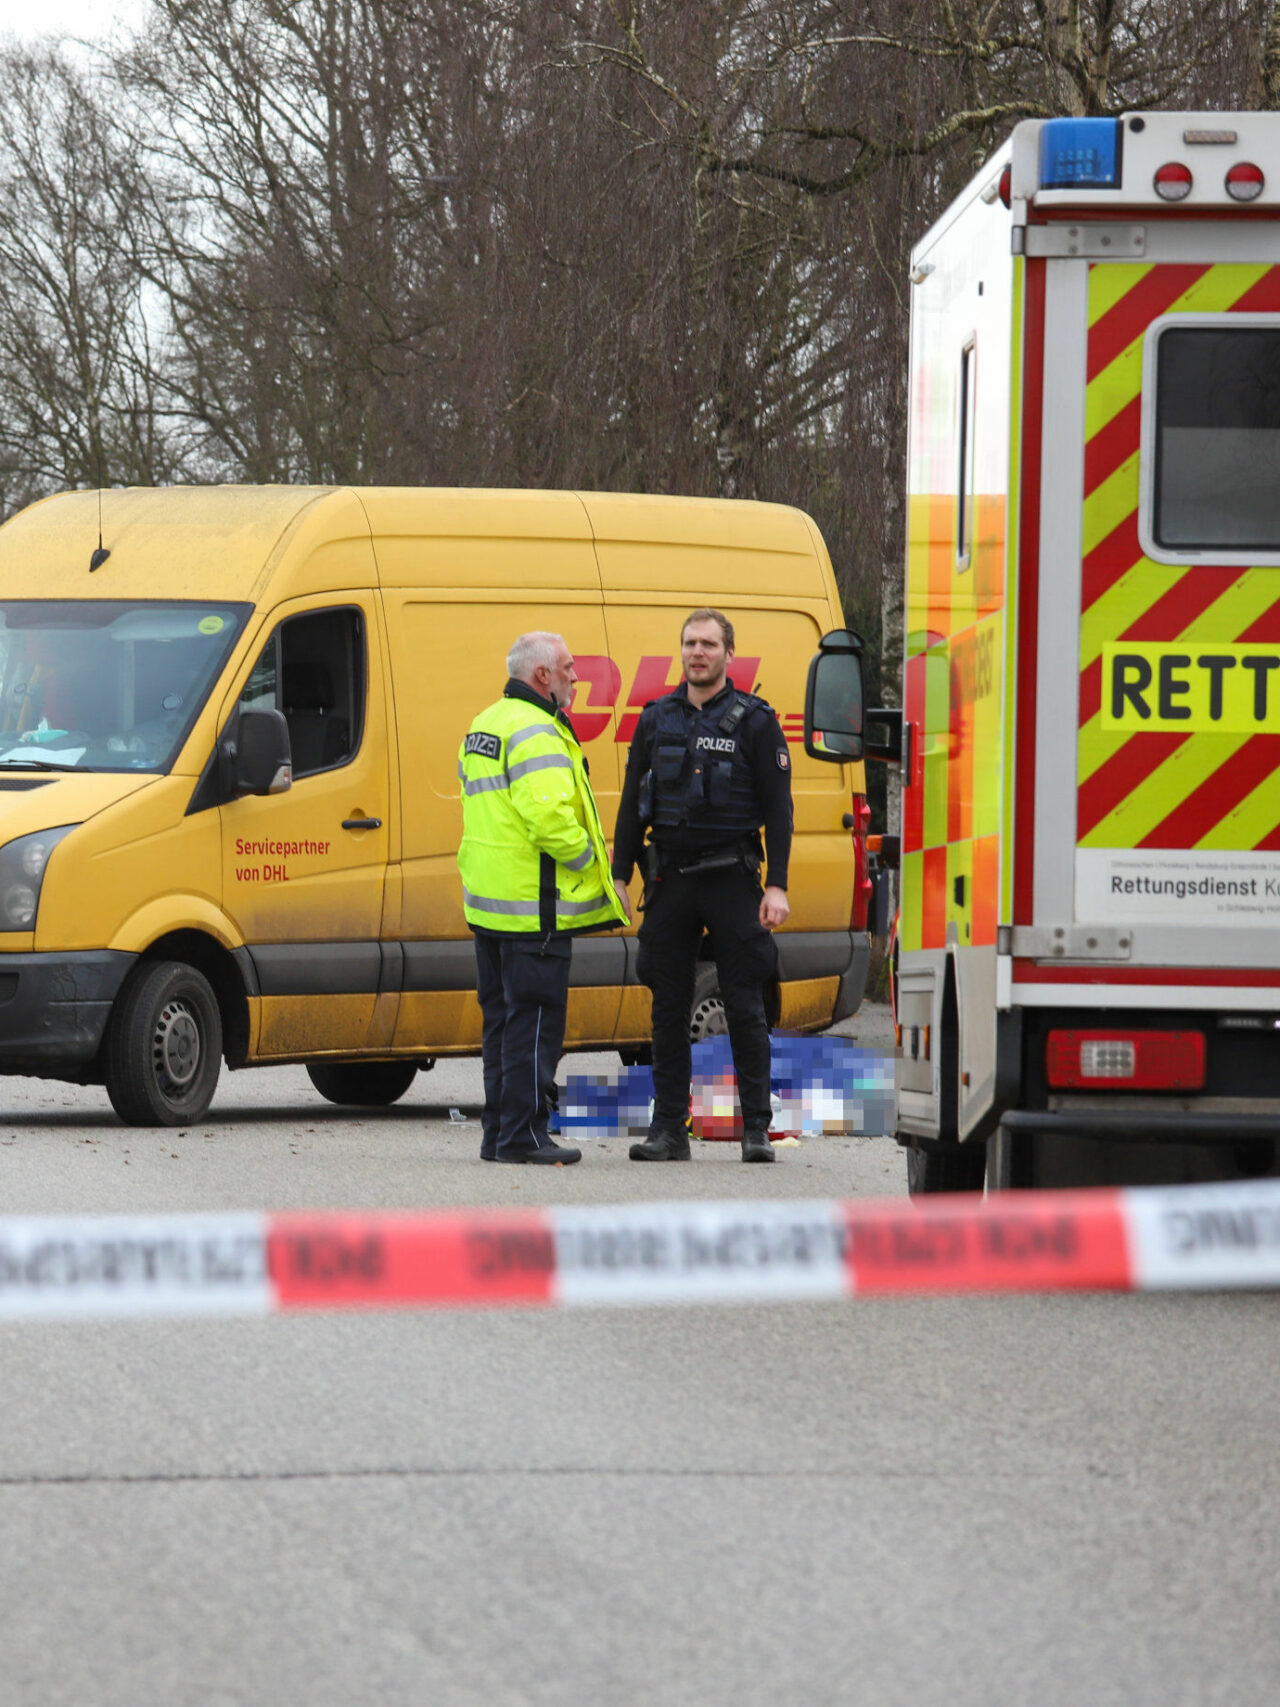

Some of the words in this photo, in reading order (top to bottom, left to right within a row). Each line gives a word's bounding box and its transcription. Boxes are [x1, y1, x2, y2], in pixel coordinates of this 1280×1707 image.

[1111, 654, 1280, 721] RETT
[696, 737, 736, 753] POLIZEI
[235, 837, 330, 859] Servicepartner
[235, 867, 260, 882] von
[263, 864, 290, 881] DHL
[1111, 875, 1258, 899] Rettungsdienst
